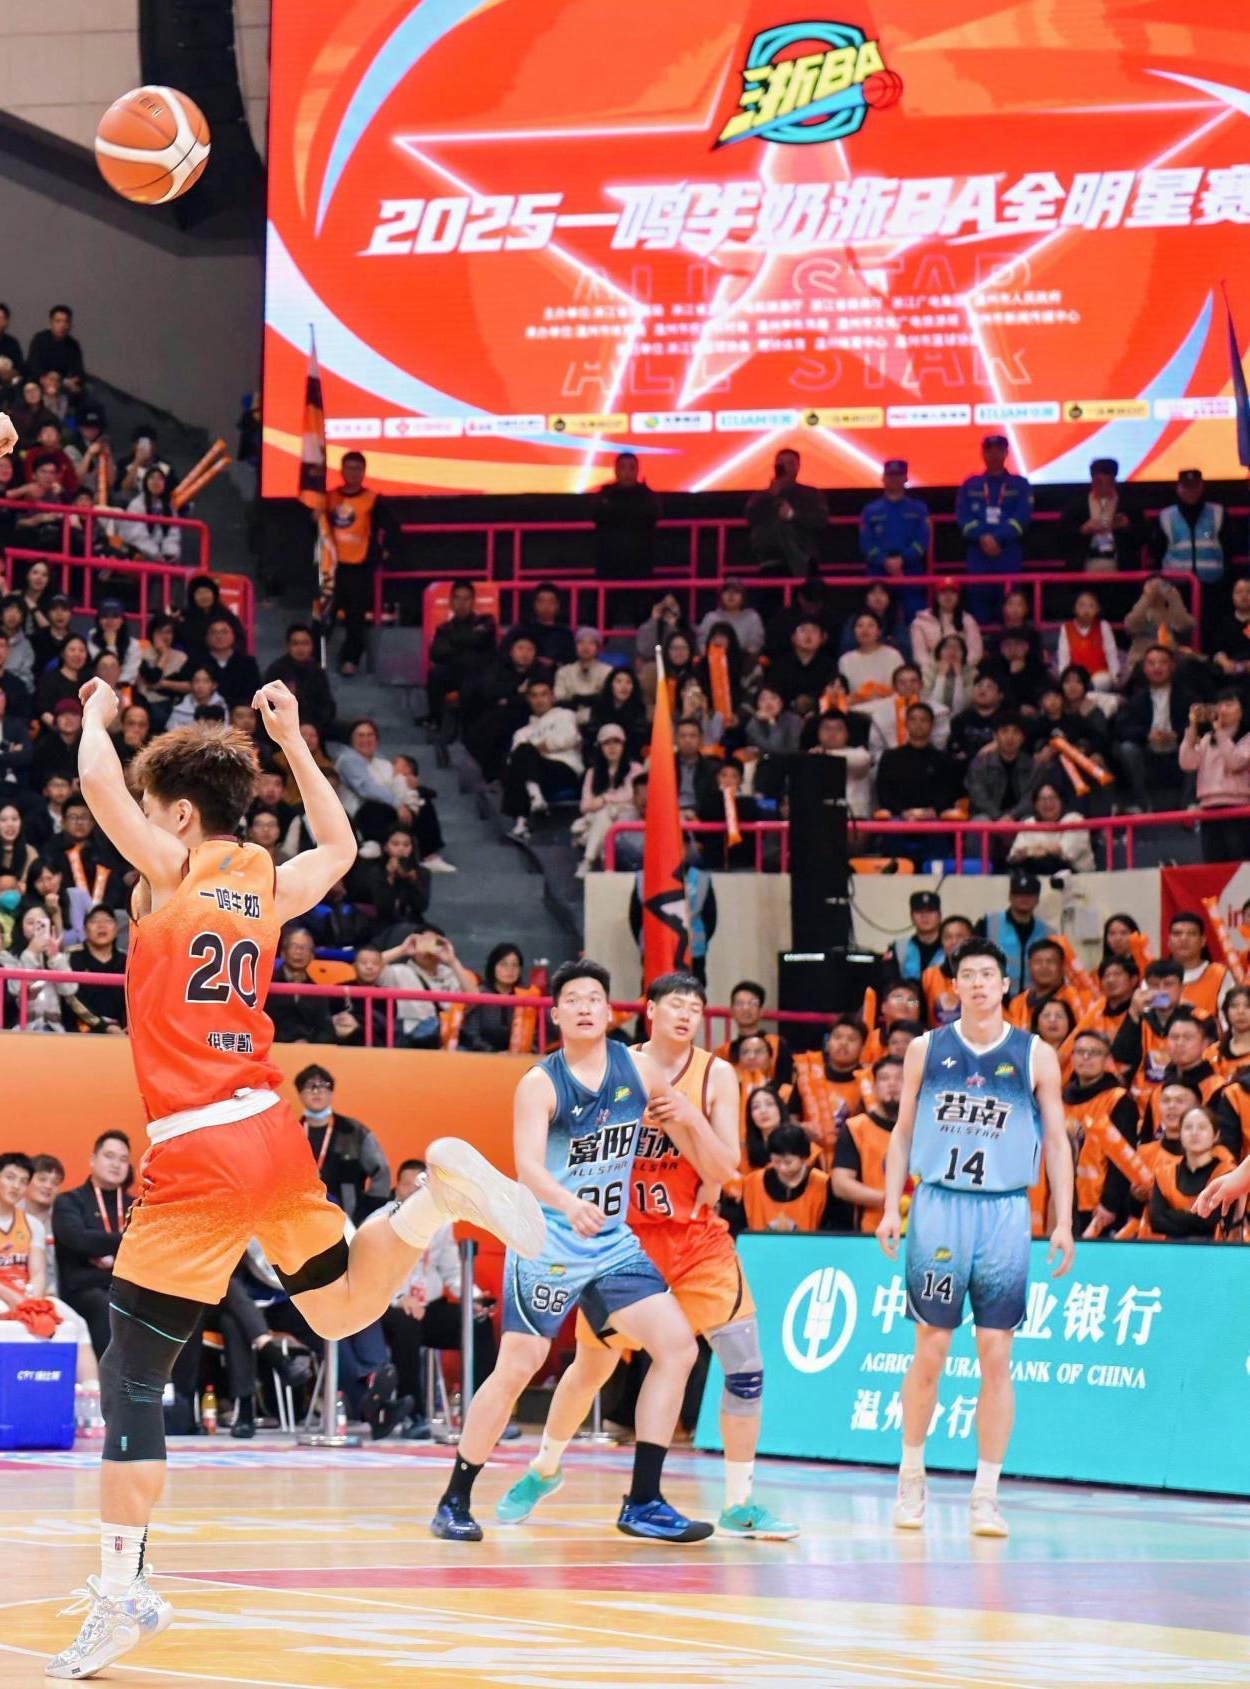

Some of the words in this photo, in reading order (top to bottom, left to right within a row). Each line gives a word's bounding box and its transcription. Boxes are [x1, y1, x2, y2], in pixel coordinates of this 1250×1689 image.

[718, 40, 885, 141] 浙BA
[199, 887, 260, 919] 一鸣牛奶
[185, 931, 260, 1009] 20
[566, 1119, 639, 1170] 富阳
[568, 1160, 629, 1177] ALLSTAR
[941, 1146, 987, 1187] 14
[634, 1180, 674, 1218] 13
[921, 1269, 954, 1305] 14
[871, 1275, 1163, 1346] 中业银行
[1009, 1360, 1052, 1383] ANK
[1056, 1362, 1084, 1385] OF
[1087, 1364, 1147, 1390] CHINA
